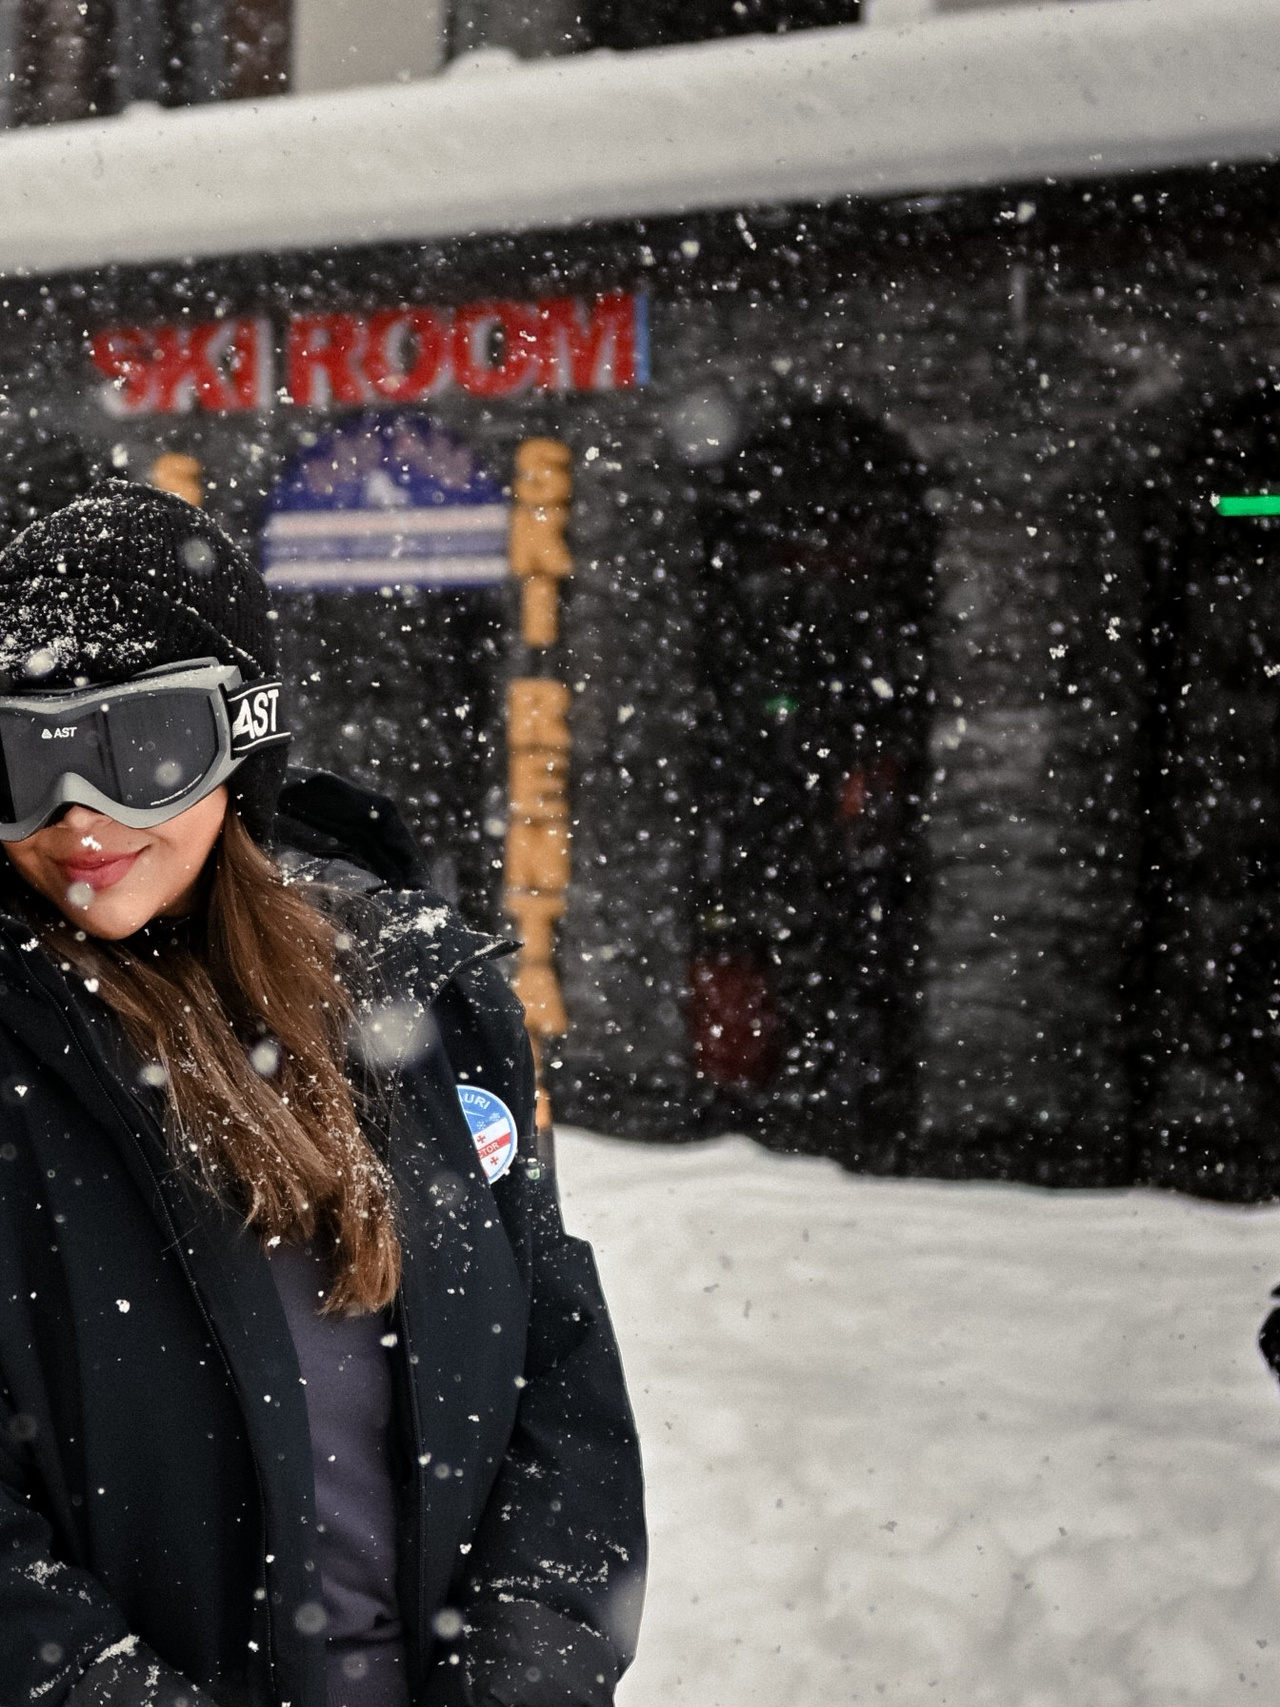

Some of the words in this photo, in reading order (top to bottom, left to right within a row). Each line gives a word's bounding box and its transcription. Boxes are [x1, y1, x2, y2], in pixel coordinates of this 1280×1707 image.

[90, 316, 271, 416] SKI
[287, 290, 637, 408] ROOM
[511, 438, 573, 645] SKI
[53, 726, 77, 738] AST
[464, 1093, 490, 1110] URI
